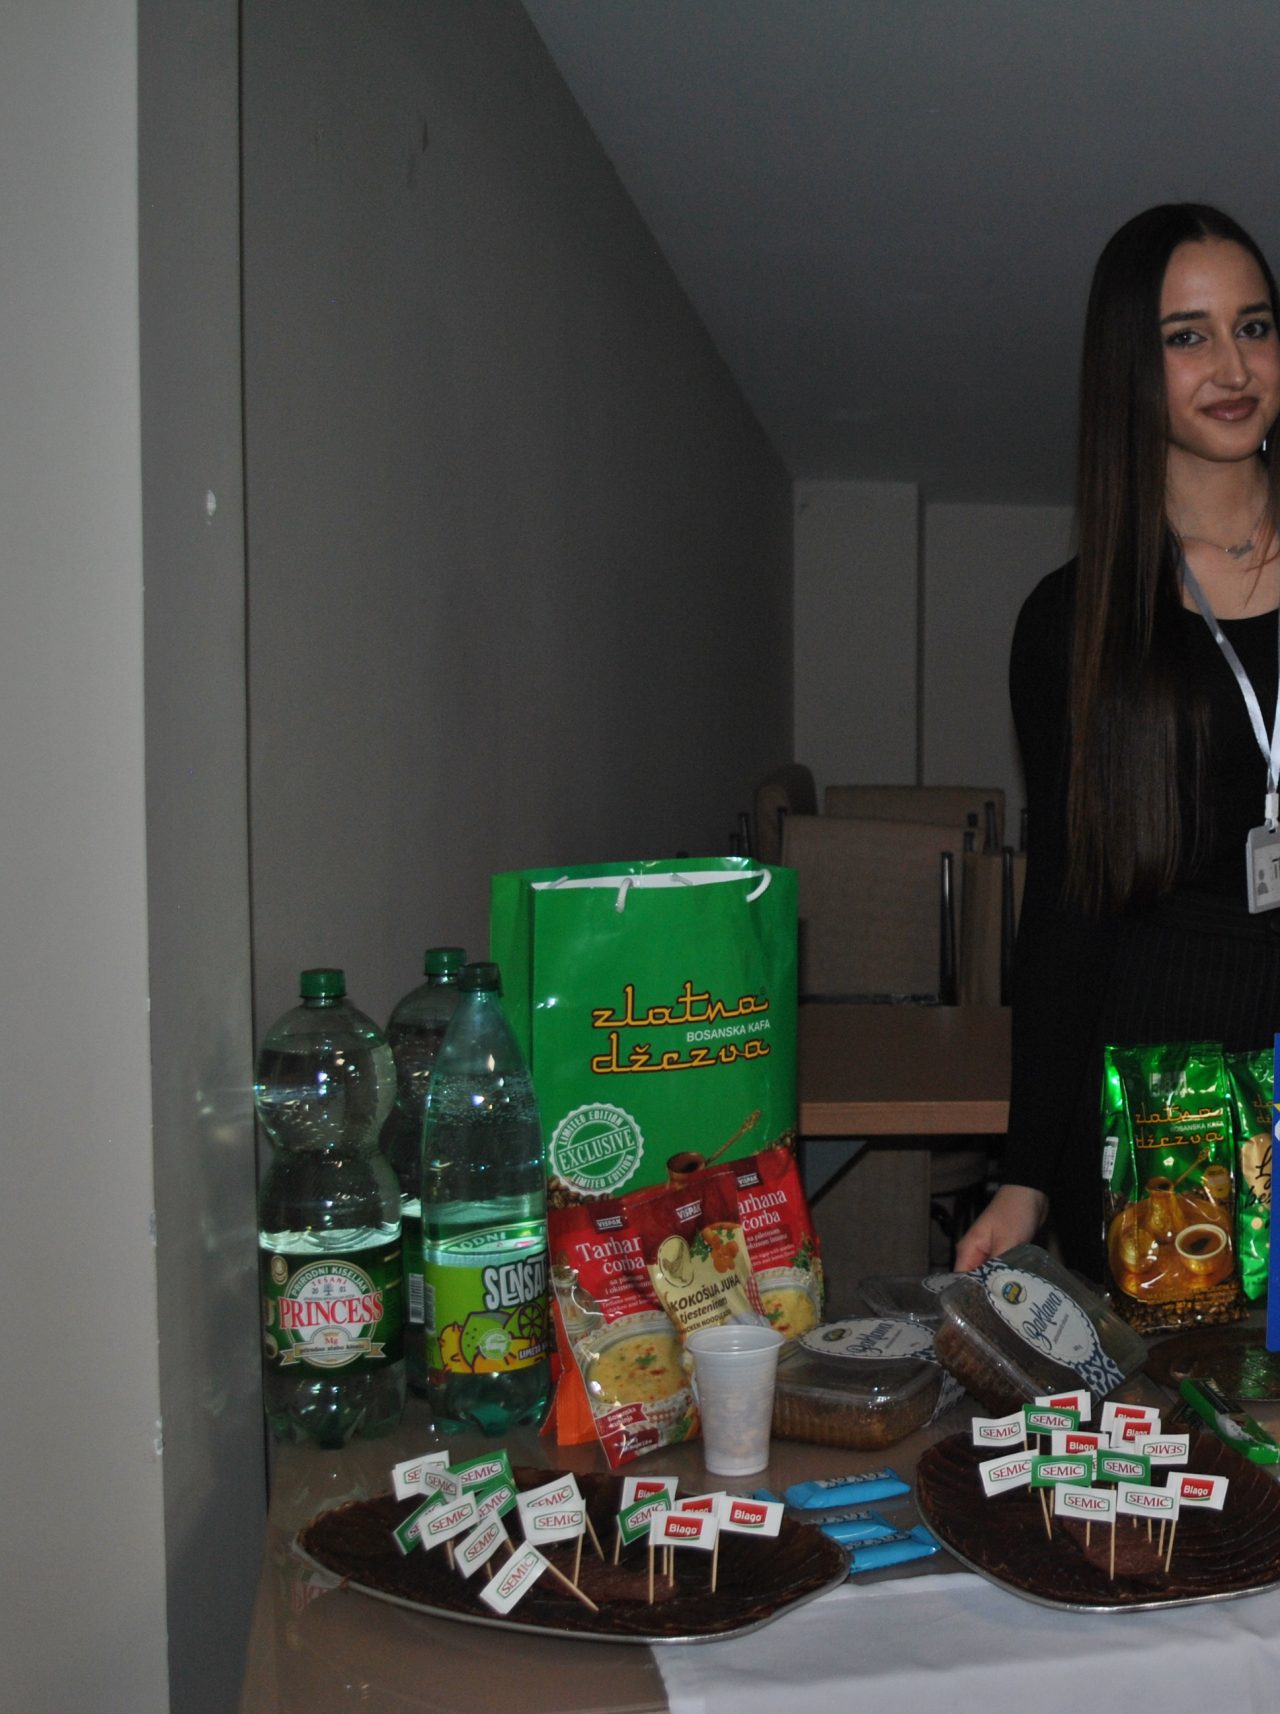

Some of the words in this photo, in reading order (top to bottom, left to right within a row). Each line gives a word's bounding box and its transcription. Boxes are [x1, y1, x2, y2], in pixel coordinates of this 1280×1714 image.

[591, 980, 769, 1028] zlatna
[686, 1024, 746, 1043] BOSANSKA
[747, 1019, 771, 1034] KAFA
[591, 1032, 771, 1075] džezva
[558, 1113, 587, 1145] LIMITED
[588, 1110, 625, 1127] EDITION
[558, 1128, 635, 1171] EXCLUSIVE
[571, 1173, 606, 1189] LIMITED
[607, 1154, 635, 1184] EDITION
[738, 1190, 787, 1215] arhana
[742, 1209, 781, 1231] čorba
[456, 1231, 508, 1250] ODNI
[292, 1266, 329, 1297] PRIRODNI
[331, 1266, 369, 1292] KISELJAK
[278, 1292, 384, 1329] PRINCESS
